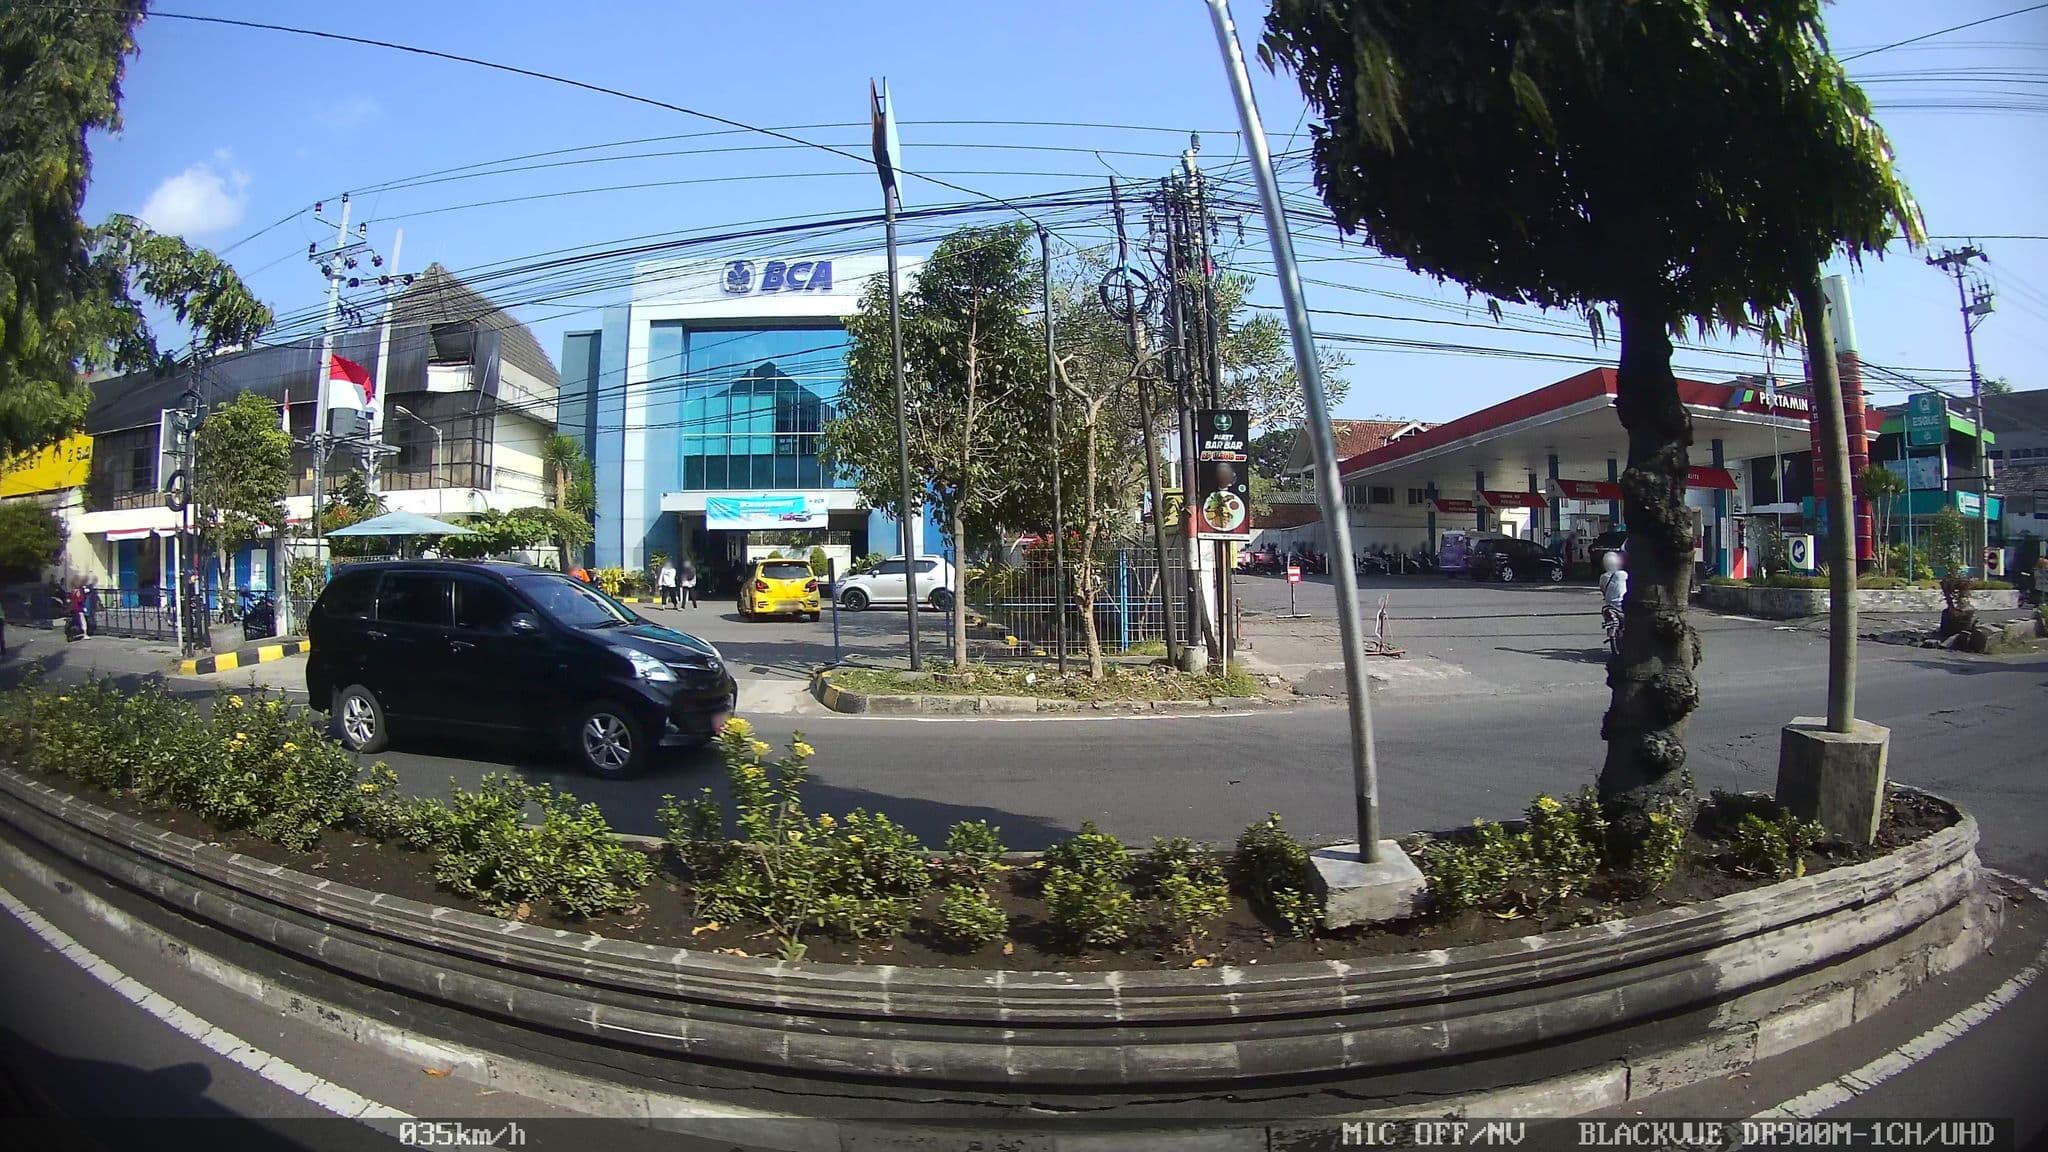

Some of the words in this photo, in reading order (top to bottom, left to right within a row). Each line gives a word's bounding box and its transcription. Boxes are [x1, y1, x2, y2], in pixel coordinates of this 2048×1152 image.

[760, 261, 833, 291] BCA
[1205, 441, 1223, 450] BAR
[1223, 441, 1243, 450] BAR
